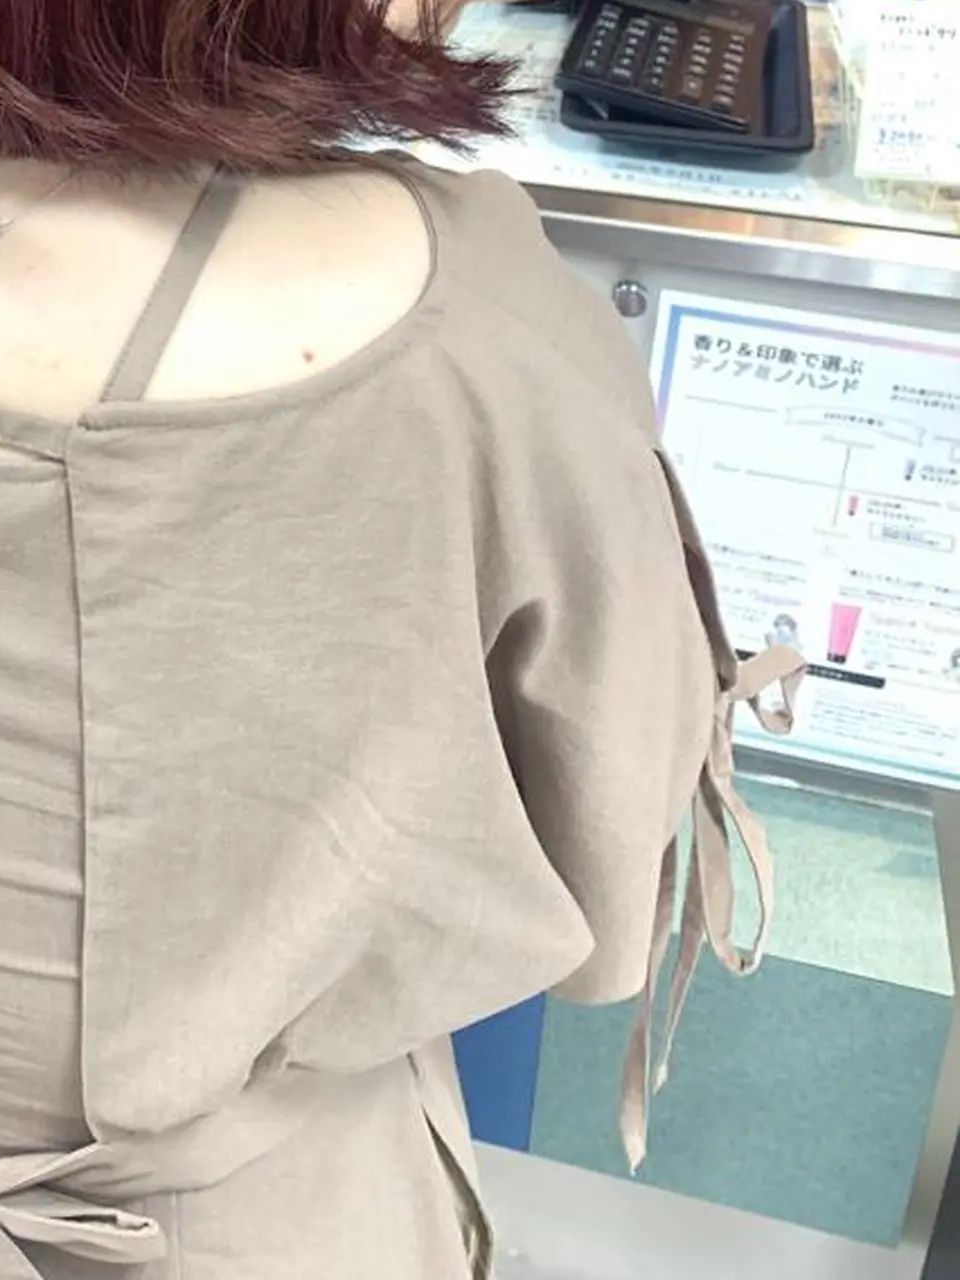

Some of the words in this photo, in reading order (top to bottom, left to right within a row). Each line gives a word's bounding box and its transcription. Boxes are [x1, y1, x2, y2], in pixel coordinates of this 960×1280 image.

[690, 353, 861, 395] ナノアミノハンド
